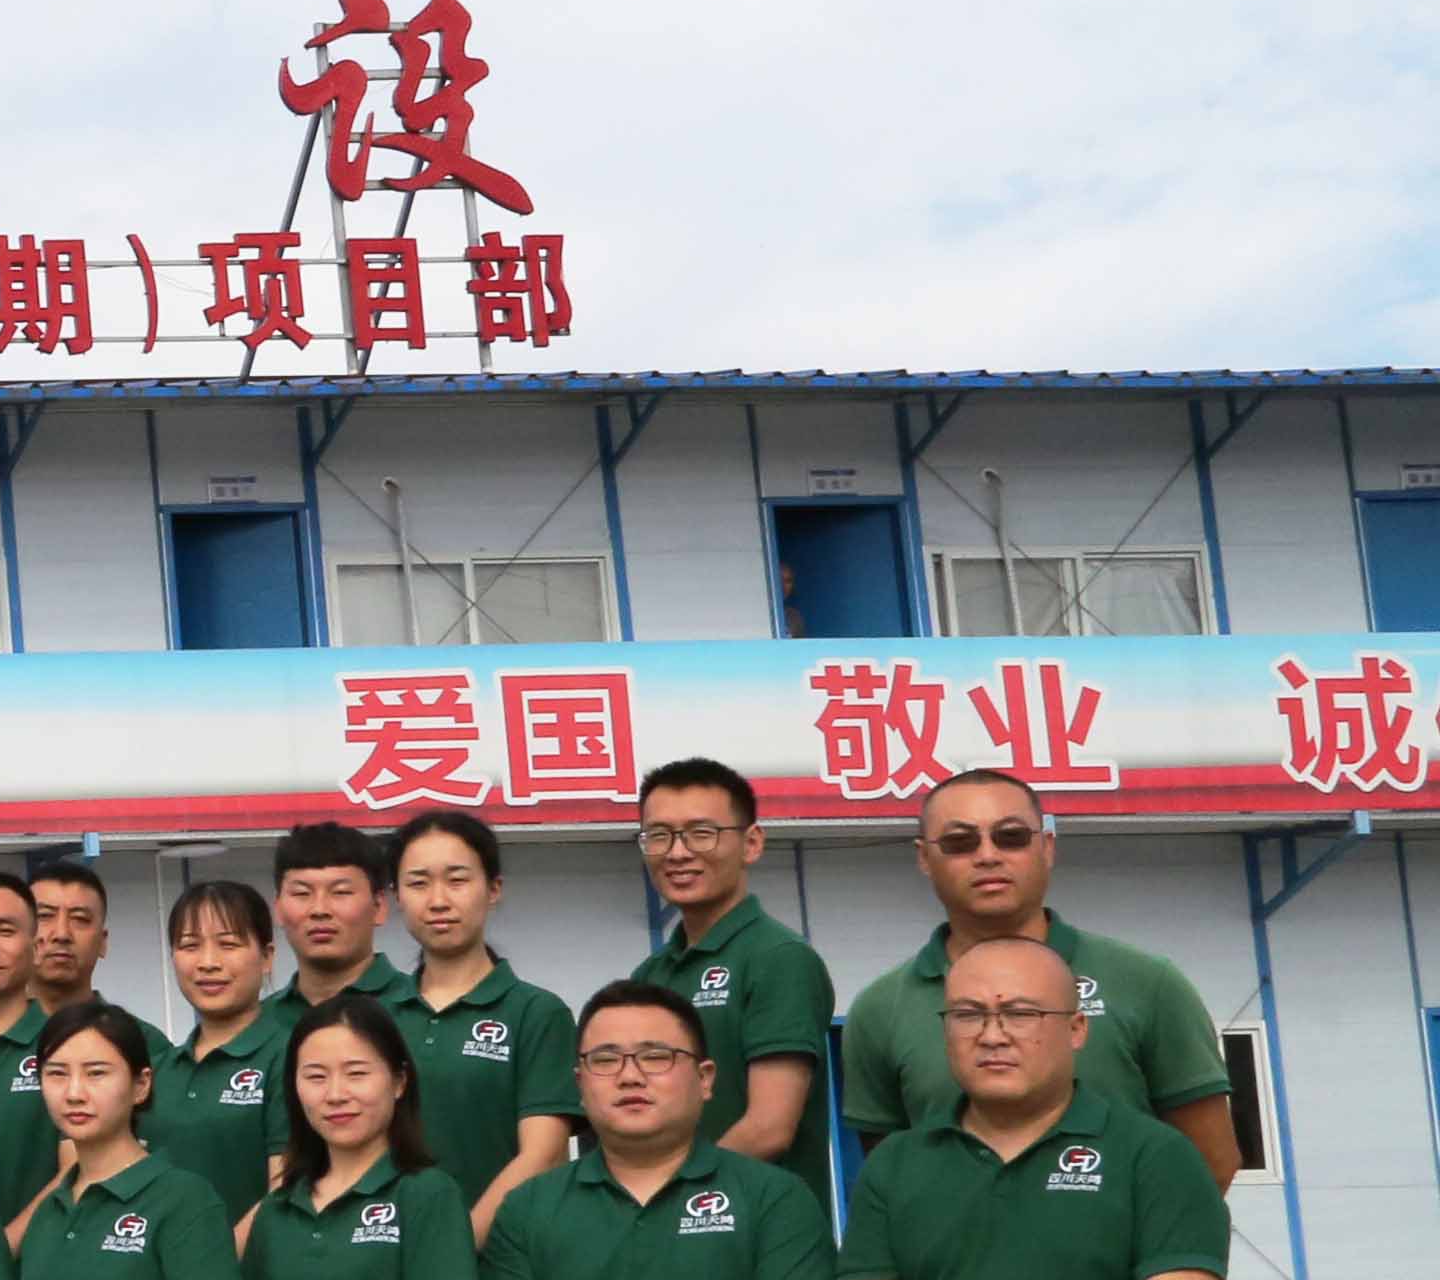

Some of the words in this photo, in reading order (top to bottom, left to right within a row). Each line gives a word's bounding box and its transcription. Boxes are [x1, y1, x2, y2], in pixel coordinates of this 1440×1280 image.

[341, 672, 638, 799] 爱国
[809, 663, 1113, 792] 敬业
[1276, 656, 1440, 785] 诚
